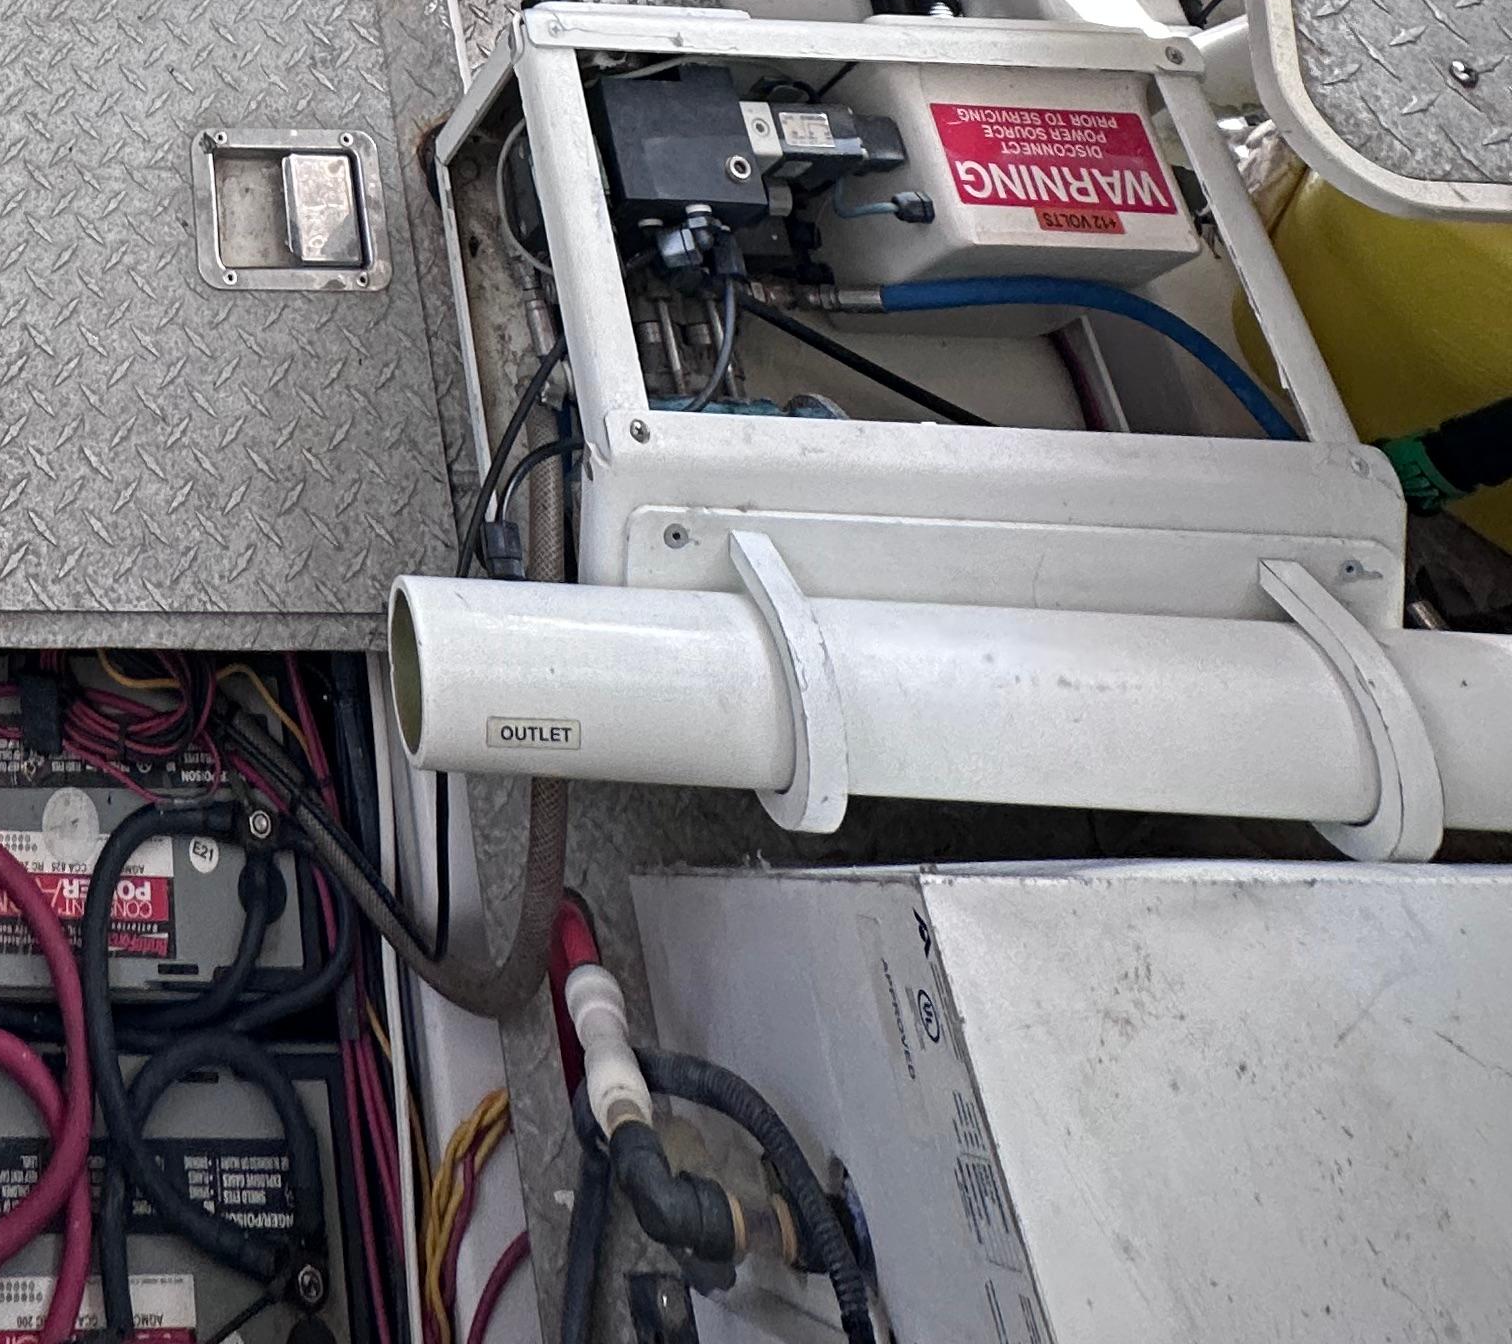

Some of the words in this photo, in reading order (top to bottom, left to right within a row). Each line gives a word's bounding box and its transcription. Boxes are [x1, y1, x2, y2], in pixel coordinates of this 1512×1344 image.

[956, 107, 1040, 124] SERVICING
[1046, 112, 1067, 126] TO
[1069, 113, 1118, 129] PRIOR
[984, 124, 1047, 141] SOURCE
[1053, 127, 1107, 143] POWER
[1001, 141, 1104, 159] DISCONNECT
[955, 160, 1169, 207] WARNING
[1045, 212, 1089, 228] VOLTS
[500, 725, 572, 743] OUTLET
[193, 841, 213, 861] E21
[63, 877, 152, 901] POER
[881, 957, 916, 1080] APPROVED
[223, 1190, 241, 1204] EYES
[16, 1315, 34, 1328] 200
